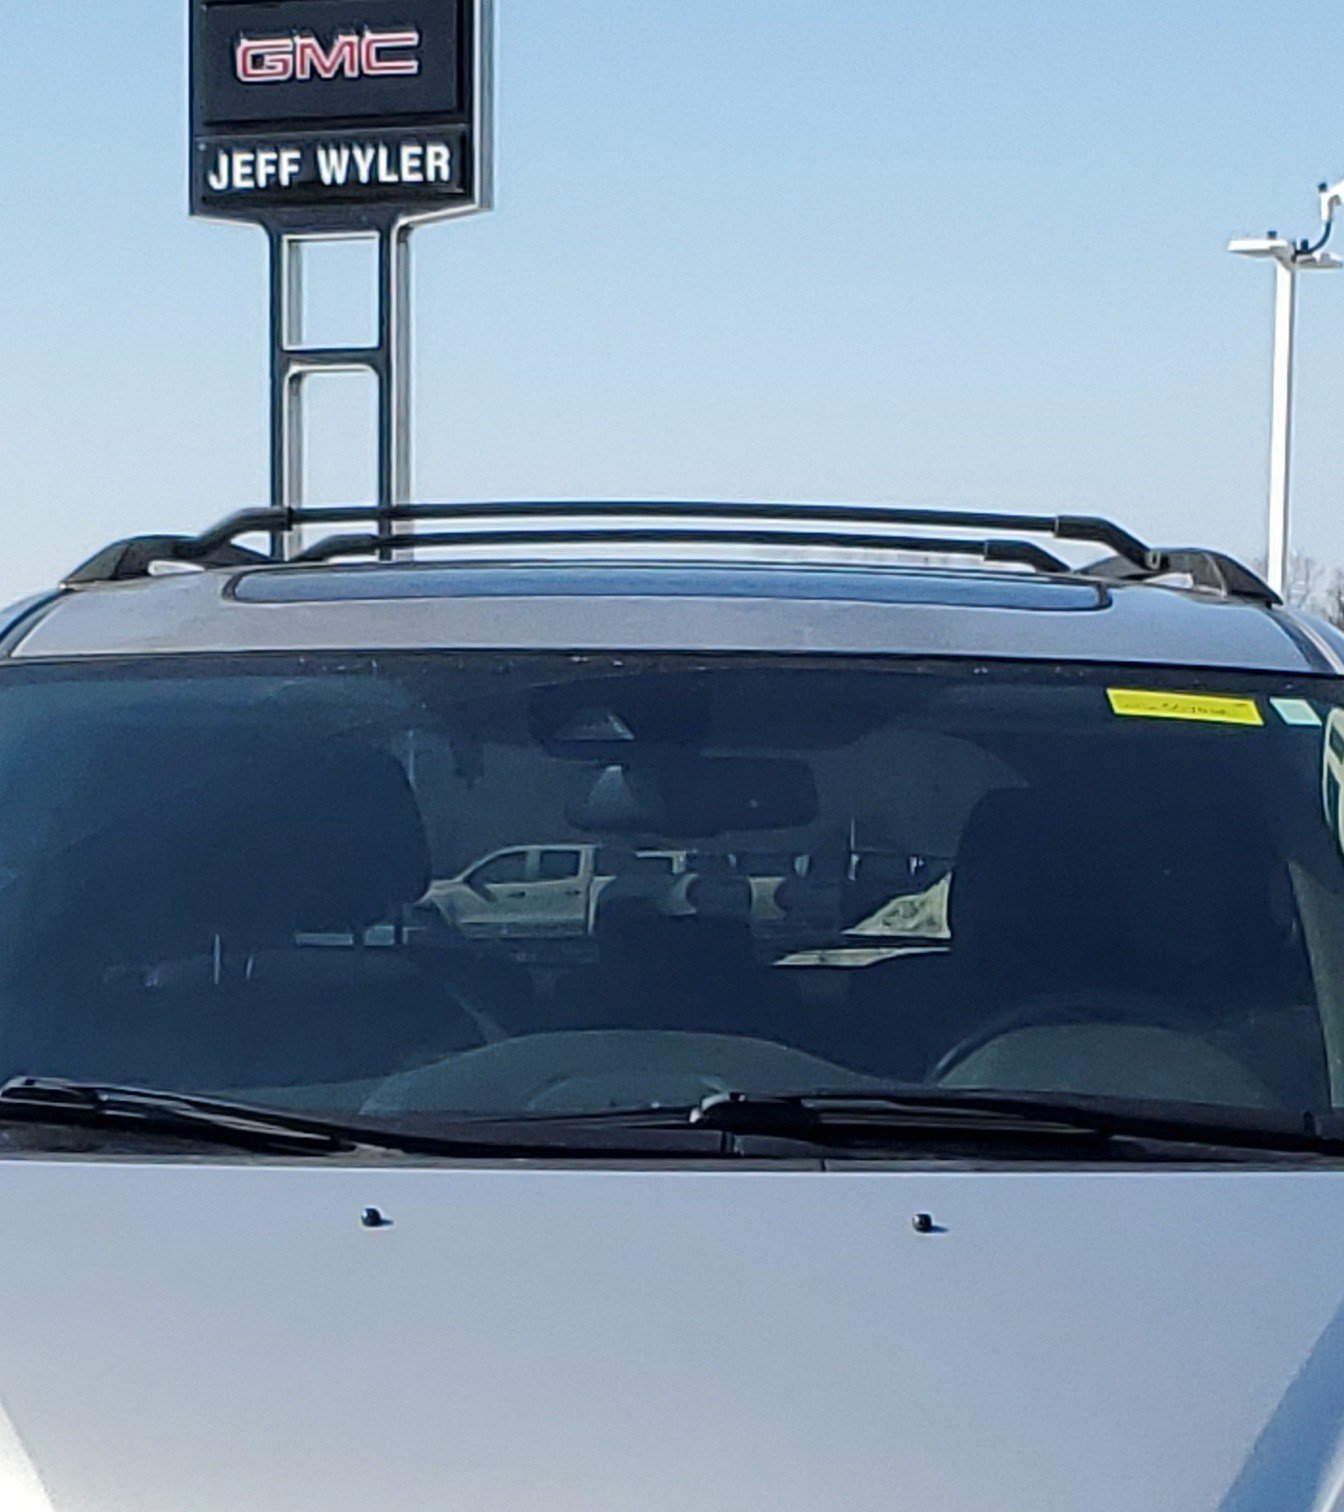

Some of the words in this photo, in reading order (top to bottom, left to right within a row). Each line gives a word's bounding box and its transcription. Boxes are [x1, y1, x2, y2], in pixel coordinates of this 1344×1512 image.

[236, 30, 419, 81] GMC
[208, 149, 301, 190] JEFF
[317, 144, 450, 185] WYLER
